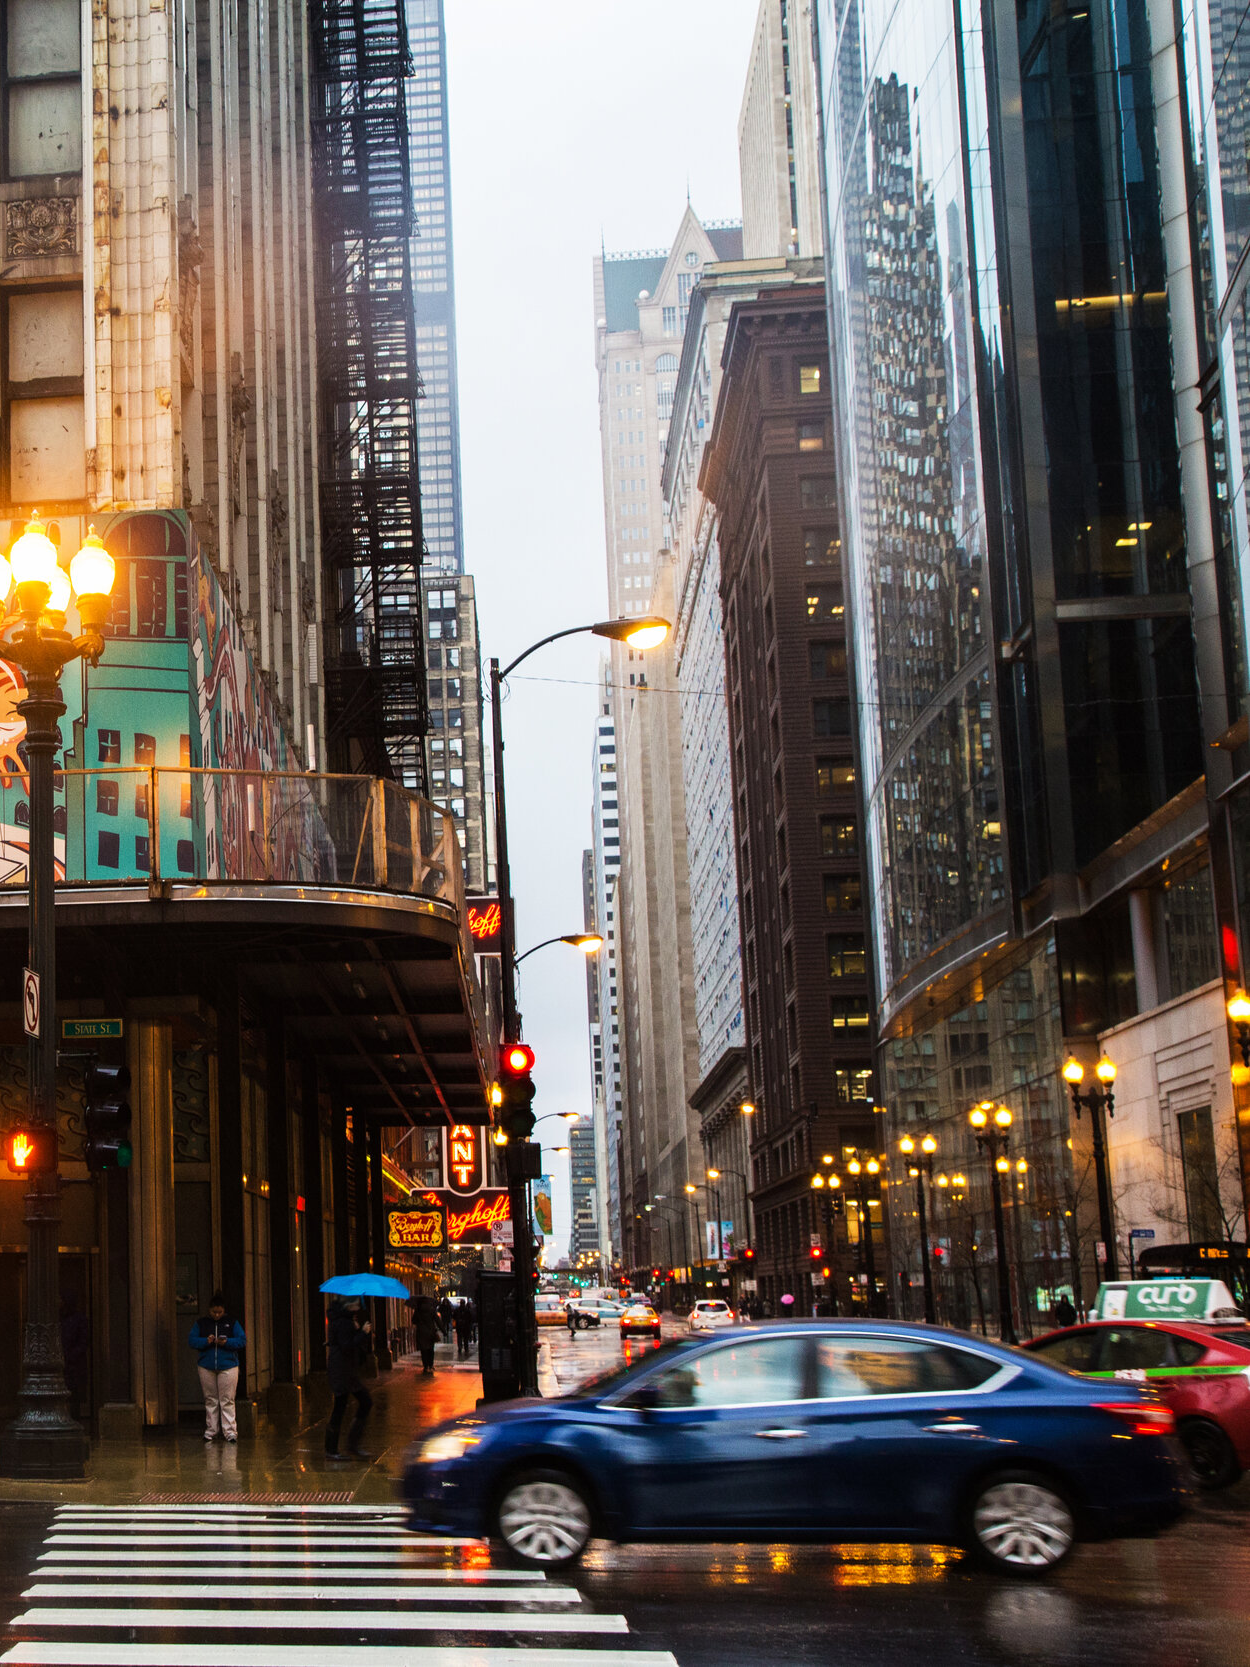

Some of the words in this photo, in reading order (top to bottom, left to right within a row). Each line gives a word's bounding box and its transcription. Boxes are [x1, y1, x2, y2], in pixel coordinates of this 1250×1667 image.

[74, 1023, 97, 1035] STATE
[402, 1233, 430, 1242] BAR
[1136, 1283, 1198, 1305] curb
